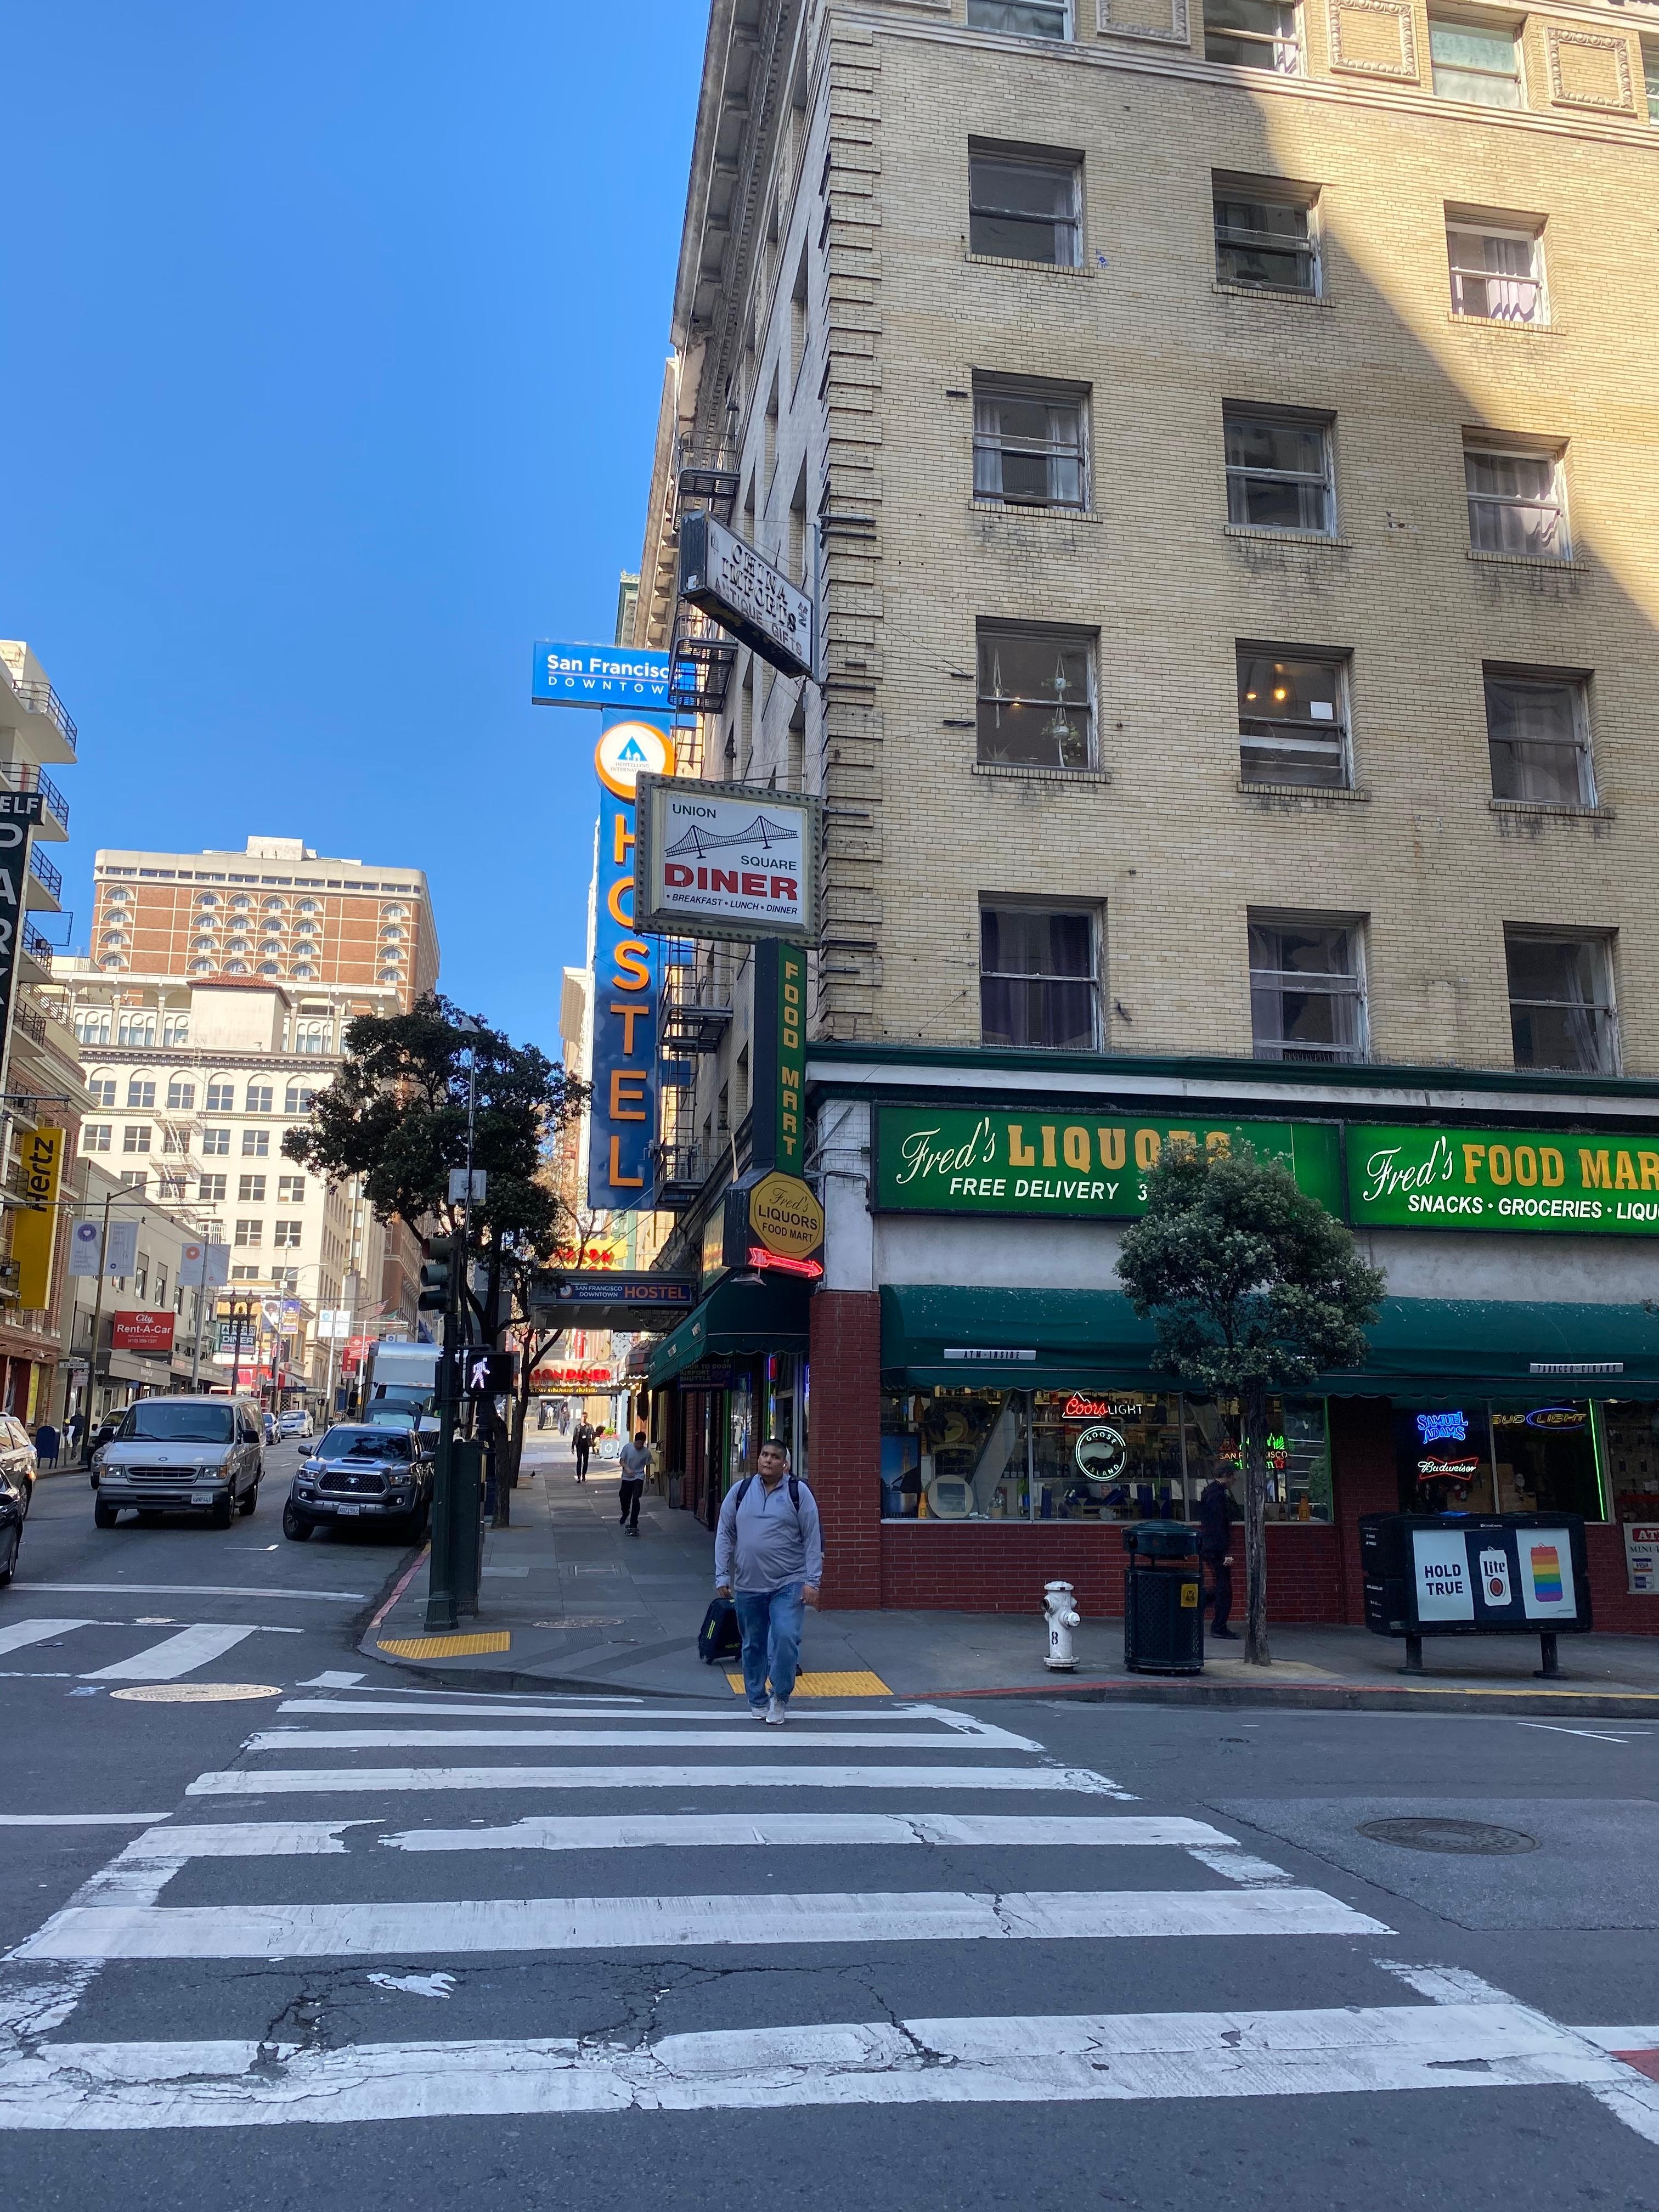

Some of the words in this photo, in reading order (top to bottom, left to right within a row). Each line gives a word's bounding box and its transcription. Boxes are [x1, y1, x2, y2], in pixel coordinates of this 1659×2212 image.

[731, 543, 788, 605] CHINA
[721, 557, 797, 632] IMPORTS
[714, 577, 763, 627] ANTIQUE
[771, 623, 803, 657] GIFTS
[547, 654, 582, 671] San
[548, 676, 665, 695] DOWNTOW
[673, 804, 716, 819] UNION
[741, 855, 797, 871] SQUARE
[664, 863, 798, 901] DINER
[672, 894, 724, 906] BREAKFAST
[730, 900, 759, 911] LUNCH
[766, 905, 798, 915] DINNER
[783, 961, 799, 1049] FOOD
[781, 1066, 799, 1156] MART
[896, 1116, 996, 1184] Fred's
[27, 1136, 54, 1213] Hertz
[1363, 1136, 1453, 1201] Fred's
[1462, 1144, 1565, 1187] FOOD
[950, 1177, 1006, 1197] FREE
[1014, 1180, 1119, 1200] DELIVERY
[769, 1188, 809, 1212] Fred's
[1408, 1194, 1483, 1214] SNACKS
[1498, 1198, 1602, 1218] GROCERIES
[1616, 1202, 1659, 1221] LIQU
[758, 1204, 817, 1230] LIQUORS
[763, 1222, 787, 1237] FOOD
[789, 1229, 813, 1243] MART
[624, 1286, 686, 1299] HOSTEL
[136, 1313, 154, 1324] City
[117, 1324, 172, 1334] Rent-A-Car
[1066, 1398, 1109, 1415] Coors
[1108, 1404, 1143, 1415] LIGHT
[1417, 1411, 1469, 1430] SAMUEL
[1492, 1414, 1525, 1425] BUD
[1536, 1413, 1587, 1424] LIGHT
[1086, 1431, 1118, 1444] GOOSE
[1423, 1426, 1466, 1444] ADAMS
[1086, 1464, 1120, 1476] ISLAND
[1418, 1461, 1477, 1474] Budweiser
[1424, 1564, 1462, 1578] HOLD
[1482, 1561, 1505, 1577] Lite
[1426, 1581, 1464, 1595] TRUE
[1051, 1631, 1058, 1645] 8
